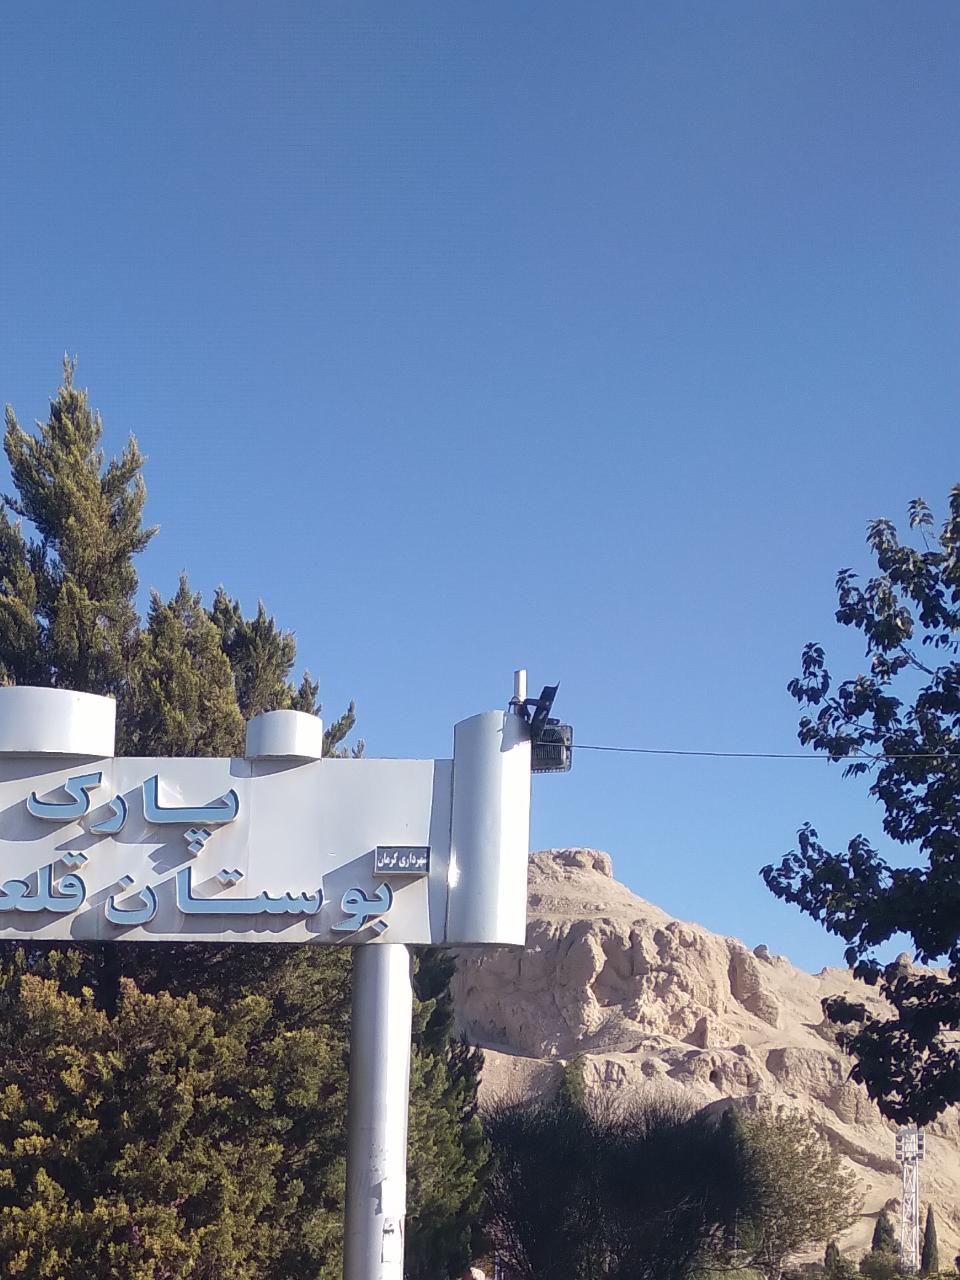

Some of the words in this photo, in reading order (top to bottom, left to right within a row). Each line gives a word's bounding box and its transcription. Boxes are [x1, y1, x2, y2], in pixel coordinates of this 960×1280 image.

[26, 771, 240, 856] پارک
[377, 851, 398, 868] کرمان
[399, 851, 427, 868] شهرداری
[104, 863, 393, 935] بوستان
